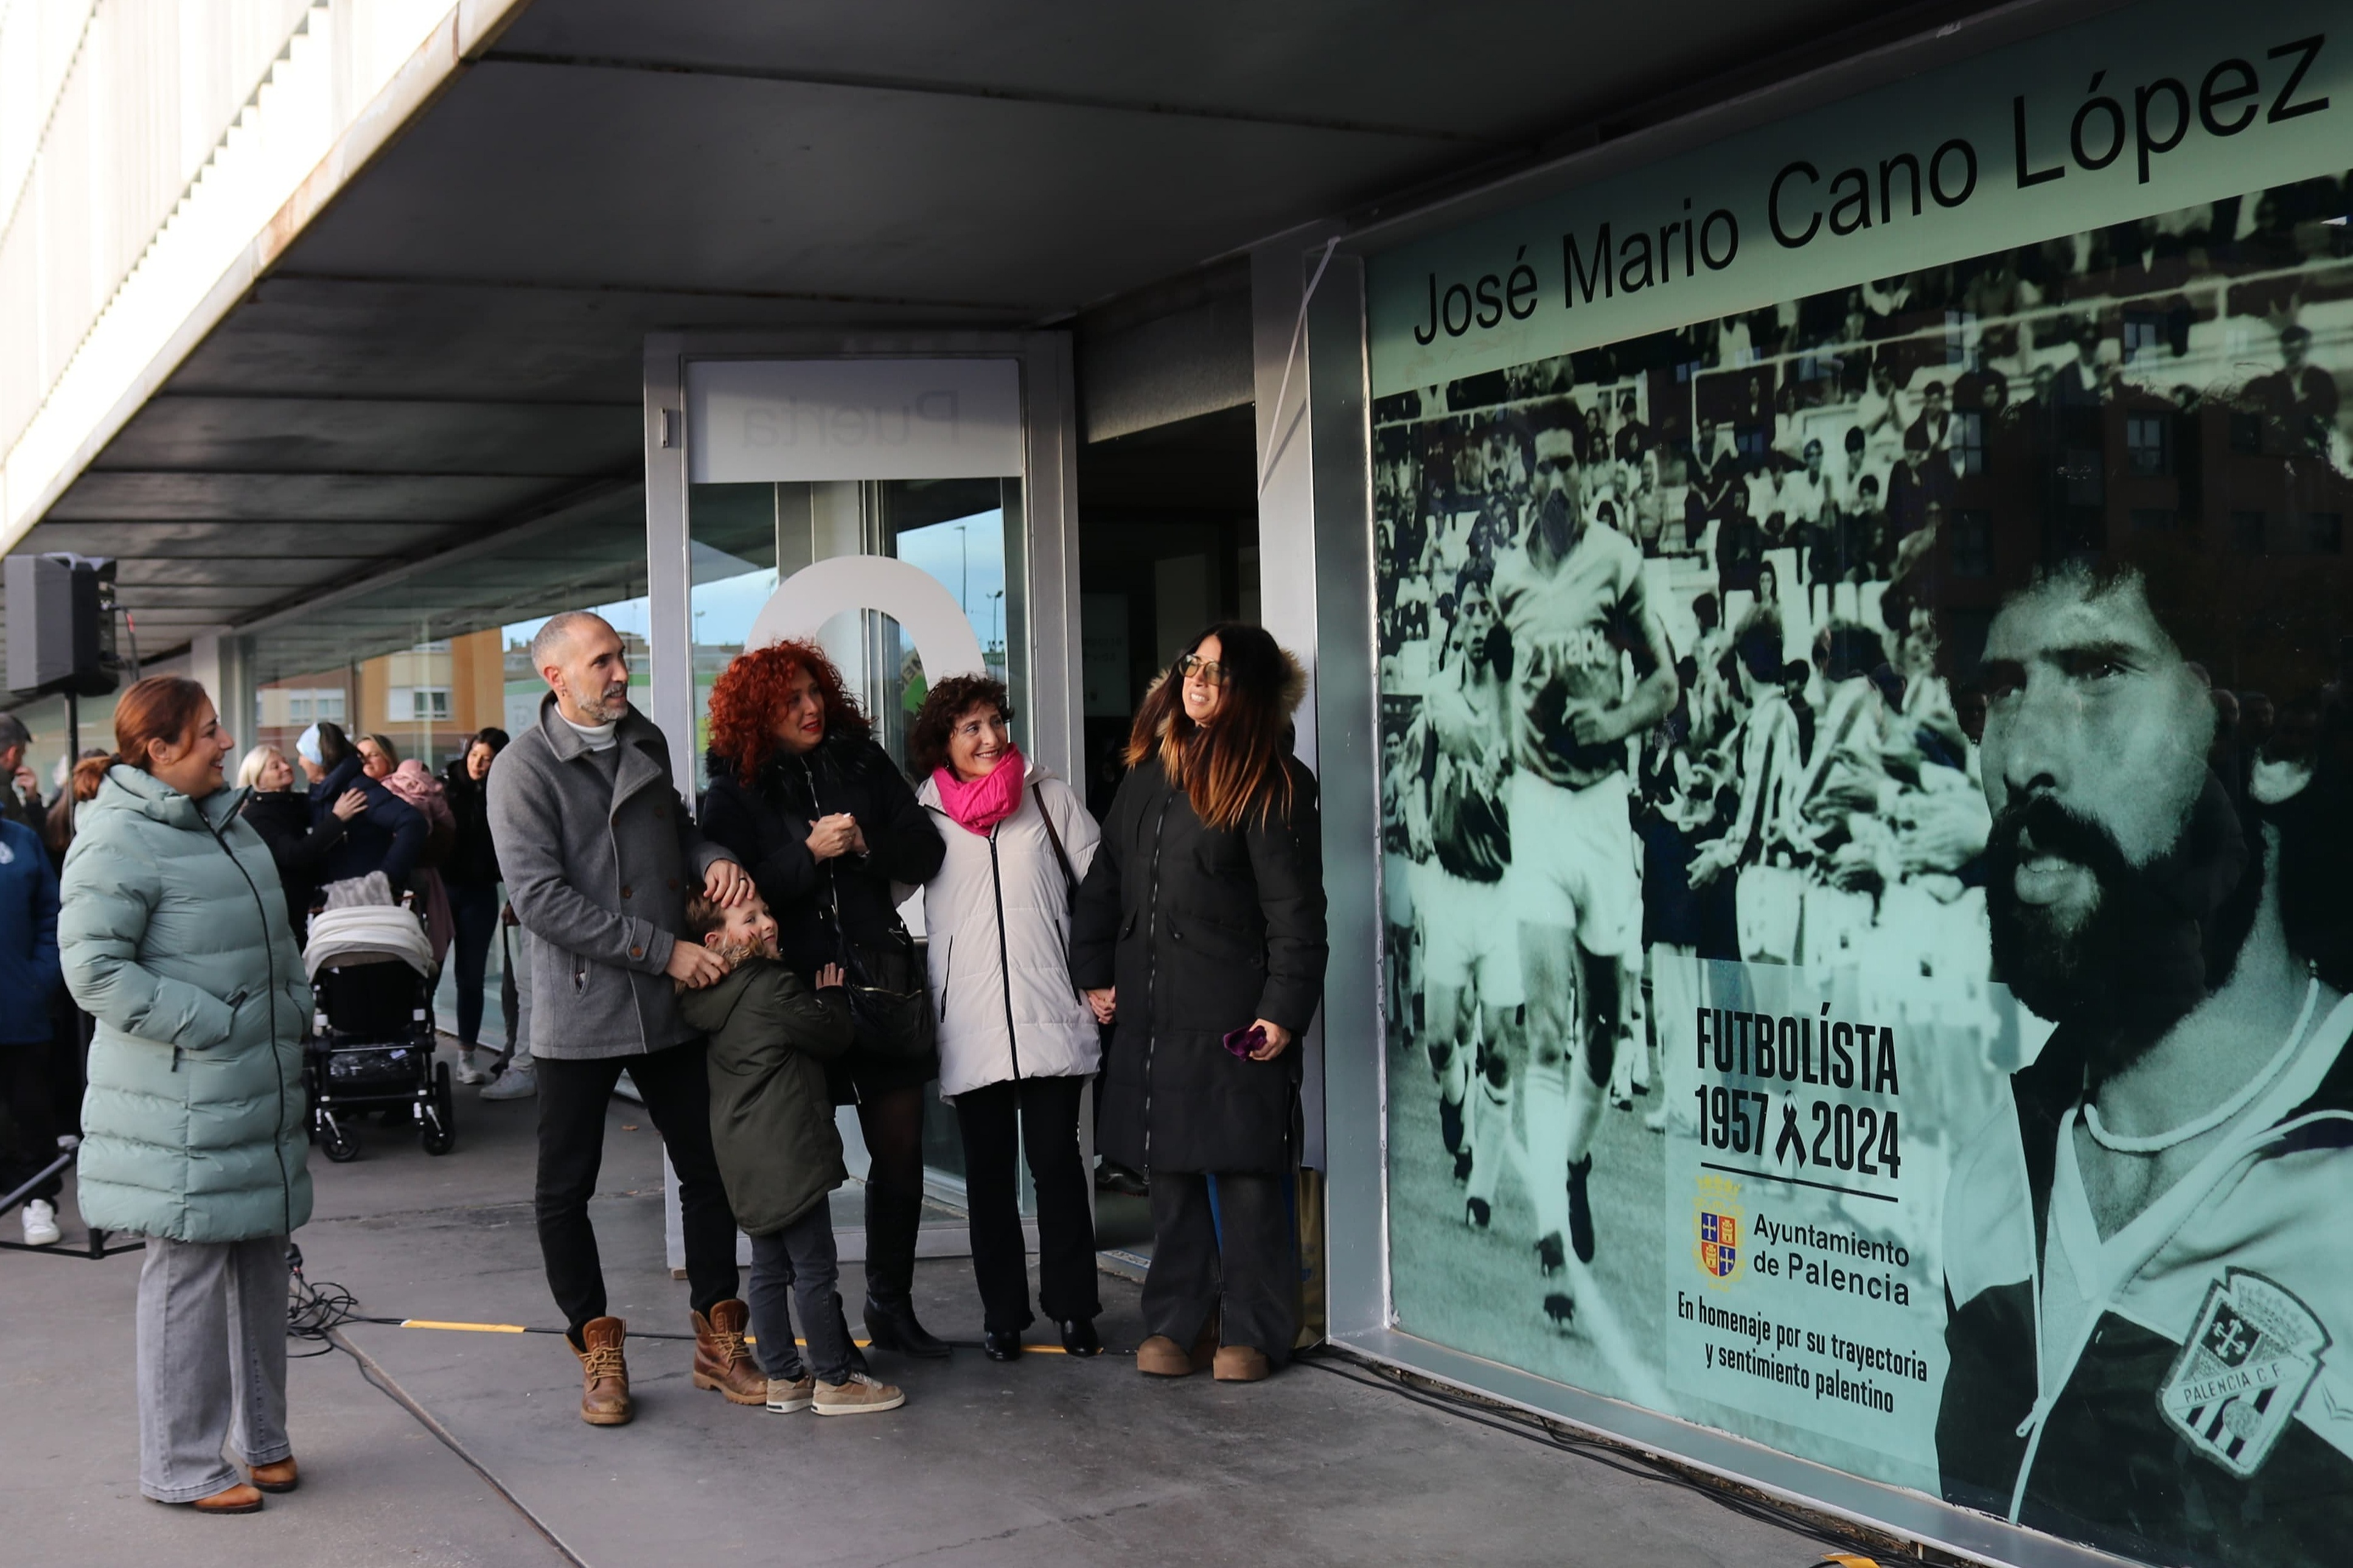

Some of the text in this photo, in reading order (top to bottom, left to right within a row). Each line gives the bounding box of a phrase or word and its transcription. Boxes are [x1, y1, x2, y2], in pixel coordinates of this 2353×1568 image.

[1414, 33, 2331, 346] José Mario Cano López
[1697, 1002, 1898, 1095] FUTBOLÍSTA
[1695, 1084, 1901, 1179] 1957 2024
[1754, 1213, 1909, 1267] Ayuntamiento
[1754, 1251, 1909, 1306] de Palencia
[1678, 1291, 1927, 1382] En homenaje por su trayectoria
[1705, 1343, 1894, 1413] y sentimiento palentino
[2184, 1372, 2251, 1404] PALENCIA
